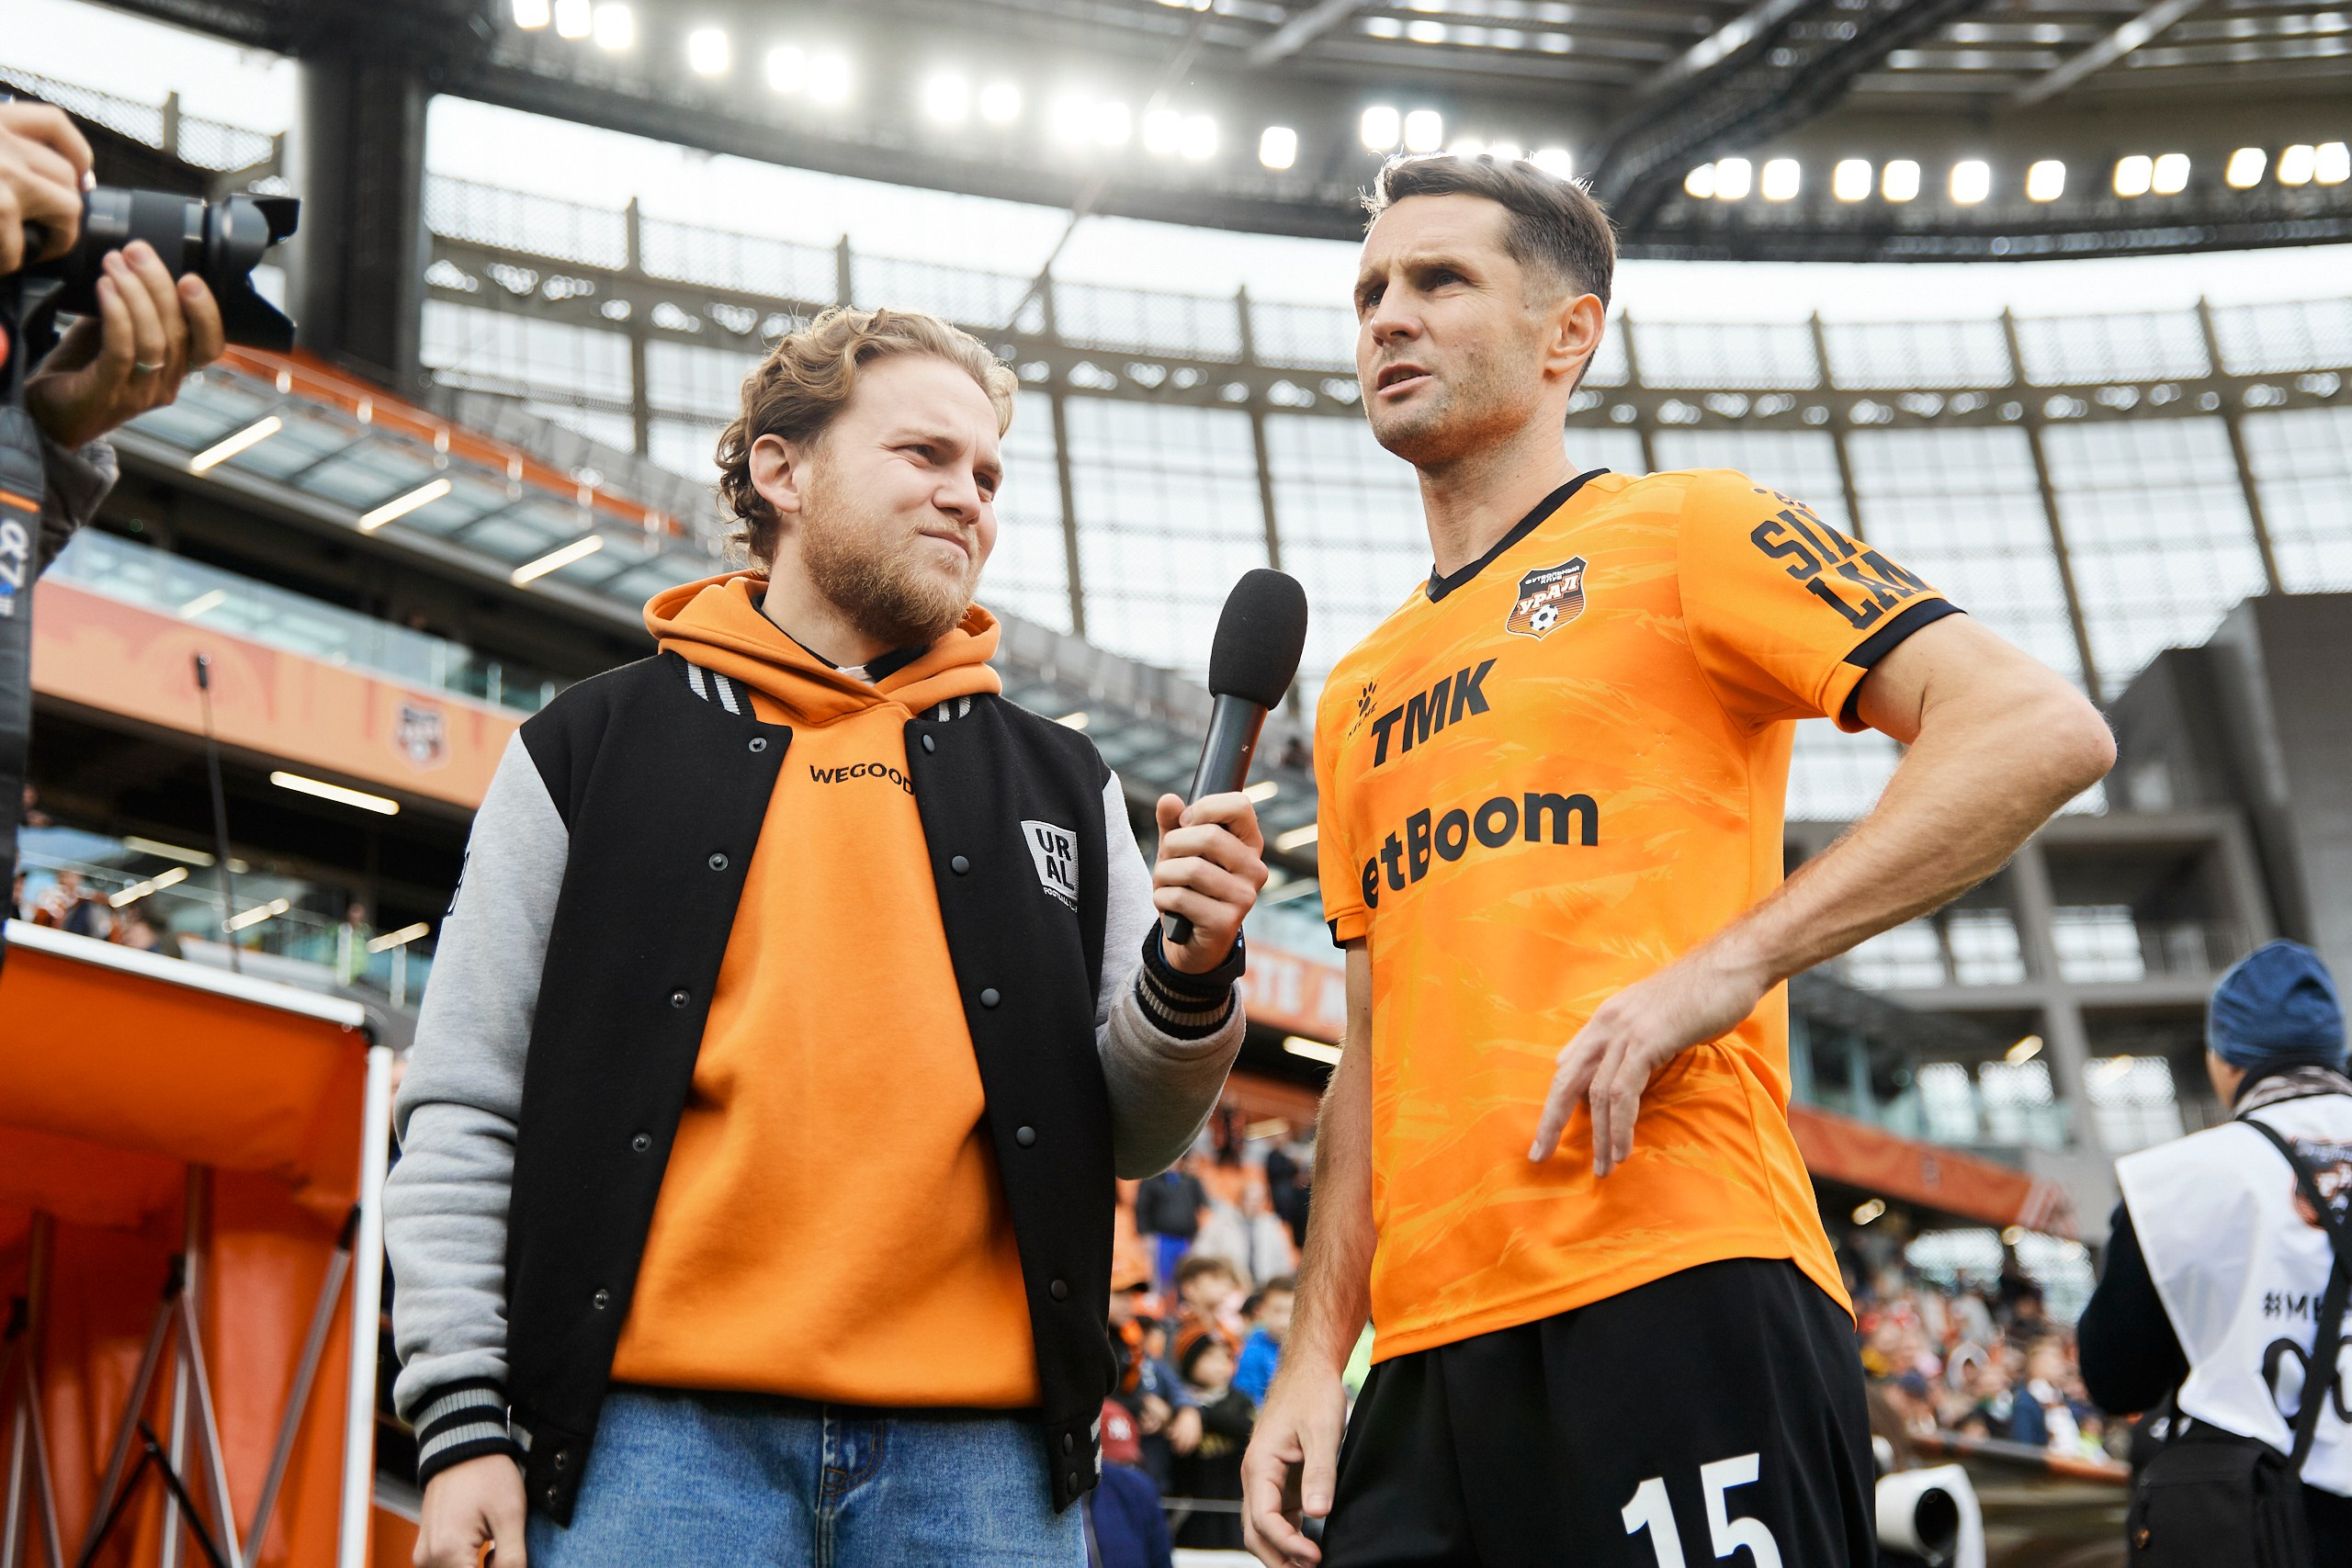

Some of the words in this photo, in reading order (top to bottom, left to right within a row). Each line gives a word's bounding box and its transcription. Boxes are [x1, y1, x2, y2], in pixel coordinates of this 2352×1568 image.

[1518, 574, 1579, 615] УРАЛ
[1371, 658, 1498, 768] TMK
[809, 762, 915, 795] WEGOOD
[1035, 829, 1071, 861] UR
[1046, 855, 1075, 891] AL
[1621, 1452, 1783, 1568] 15
